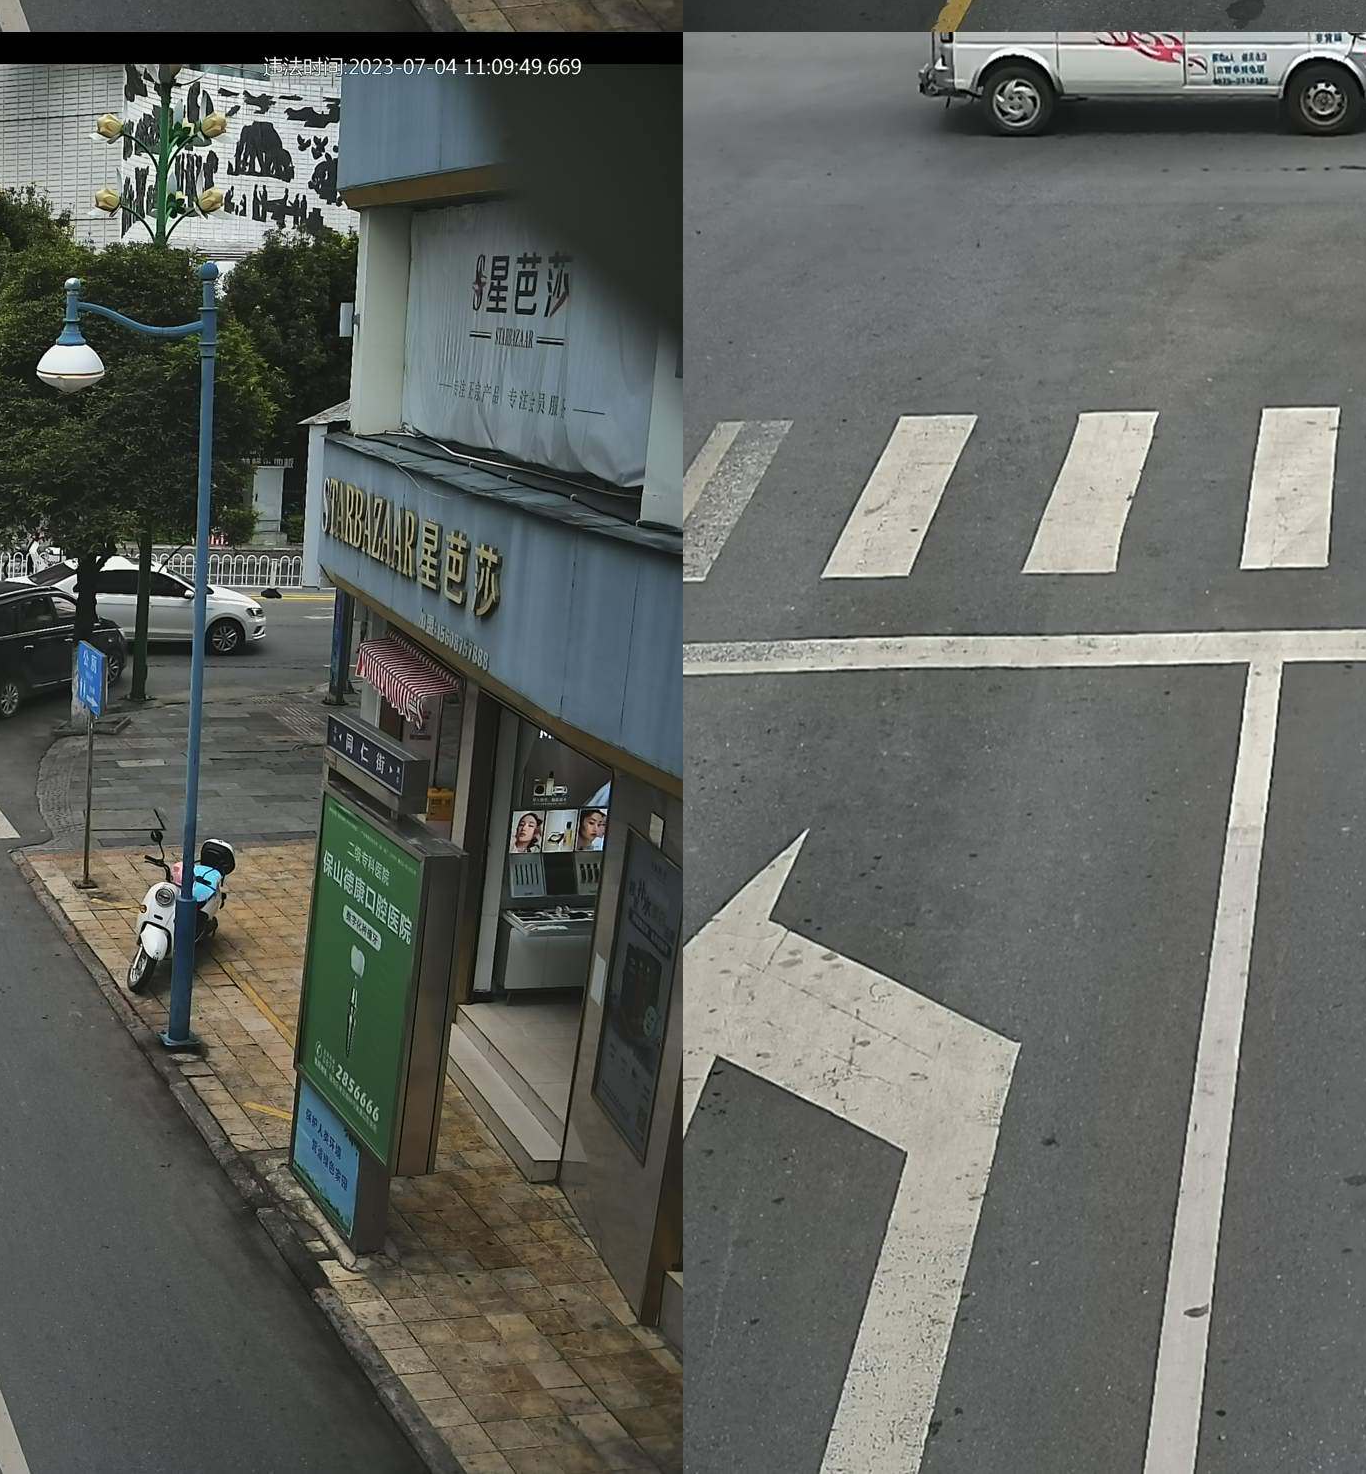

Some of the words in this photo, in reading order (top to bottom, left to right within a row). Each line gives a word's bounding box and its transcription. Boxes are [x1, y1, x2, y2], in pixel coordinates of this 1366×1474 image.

[484, 251, 575, 318] 星芭莎
[321, 476, 419, 579] STARBAZAAR
[418, 518, 503, 617] 星芭莎
[345, 732, 386, 775] 同仁街
[347, 841, 391, 886] 二级专科医院
[322, 849, 413, 945] 保山德康口腔医院
[335, 1064, 380, 1122] 2856666
